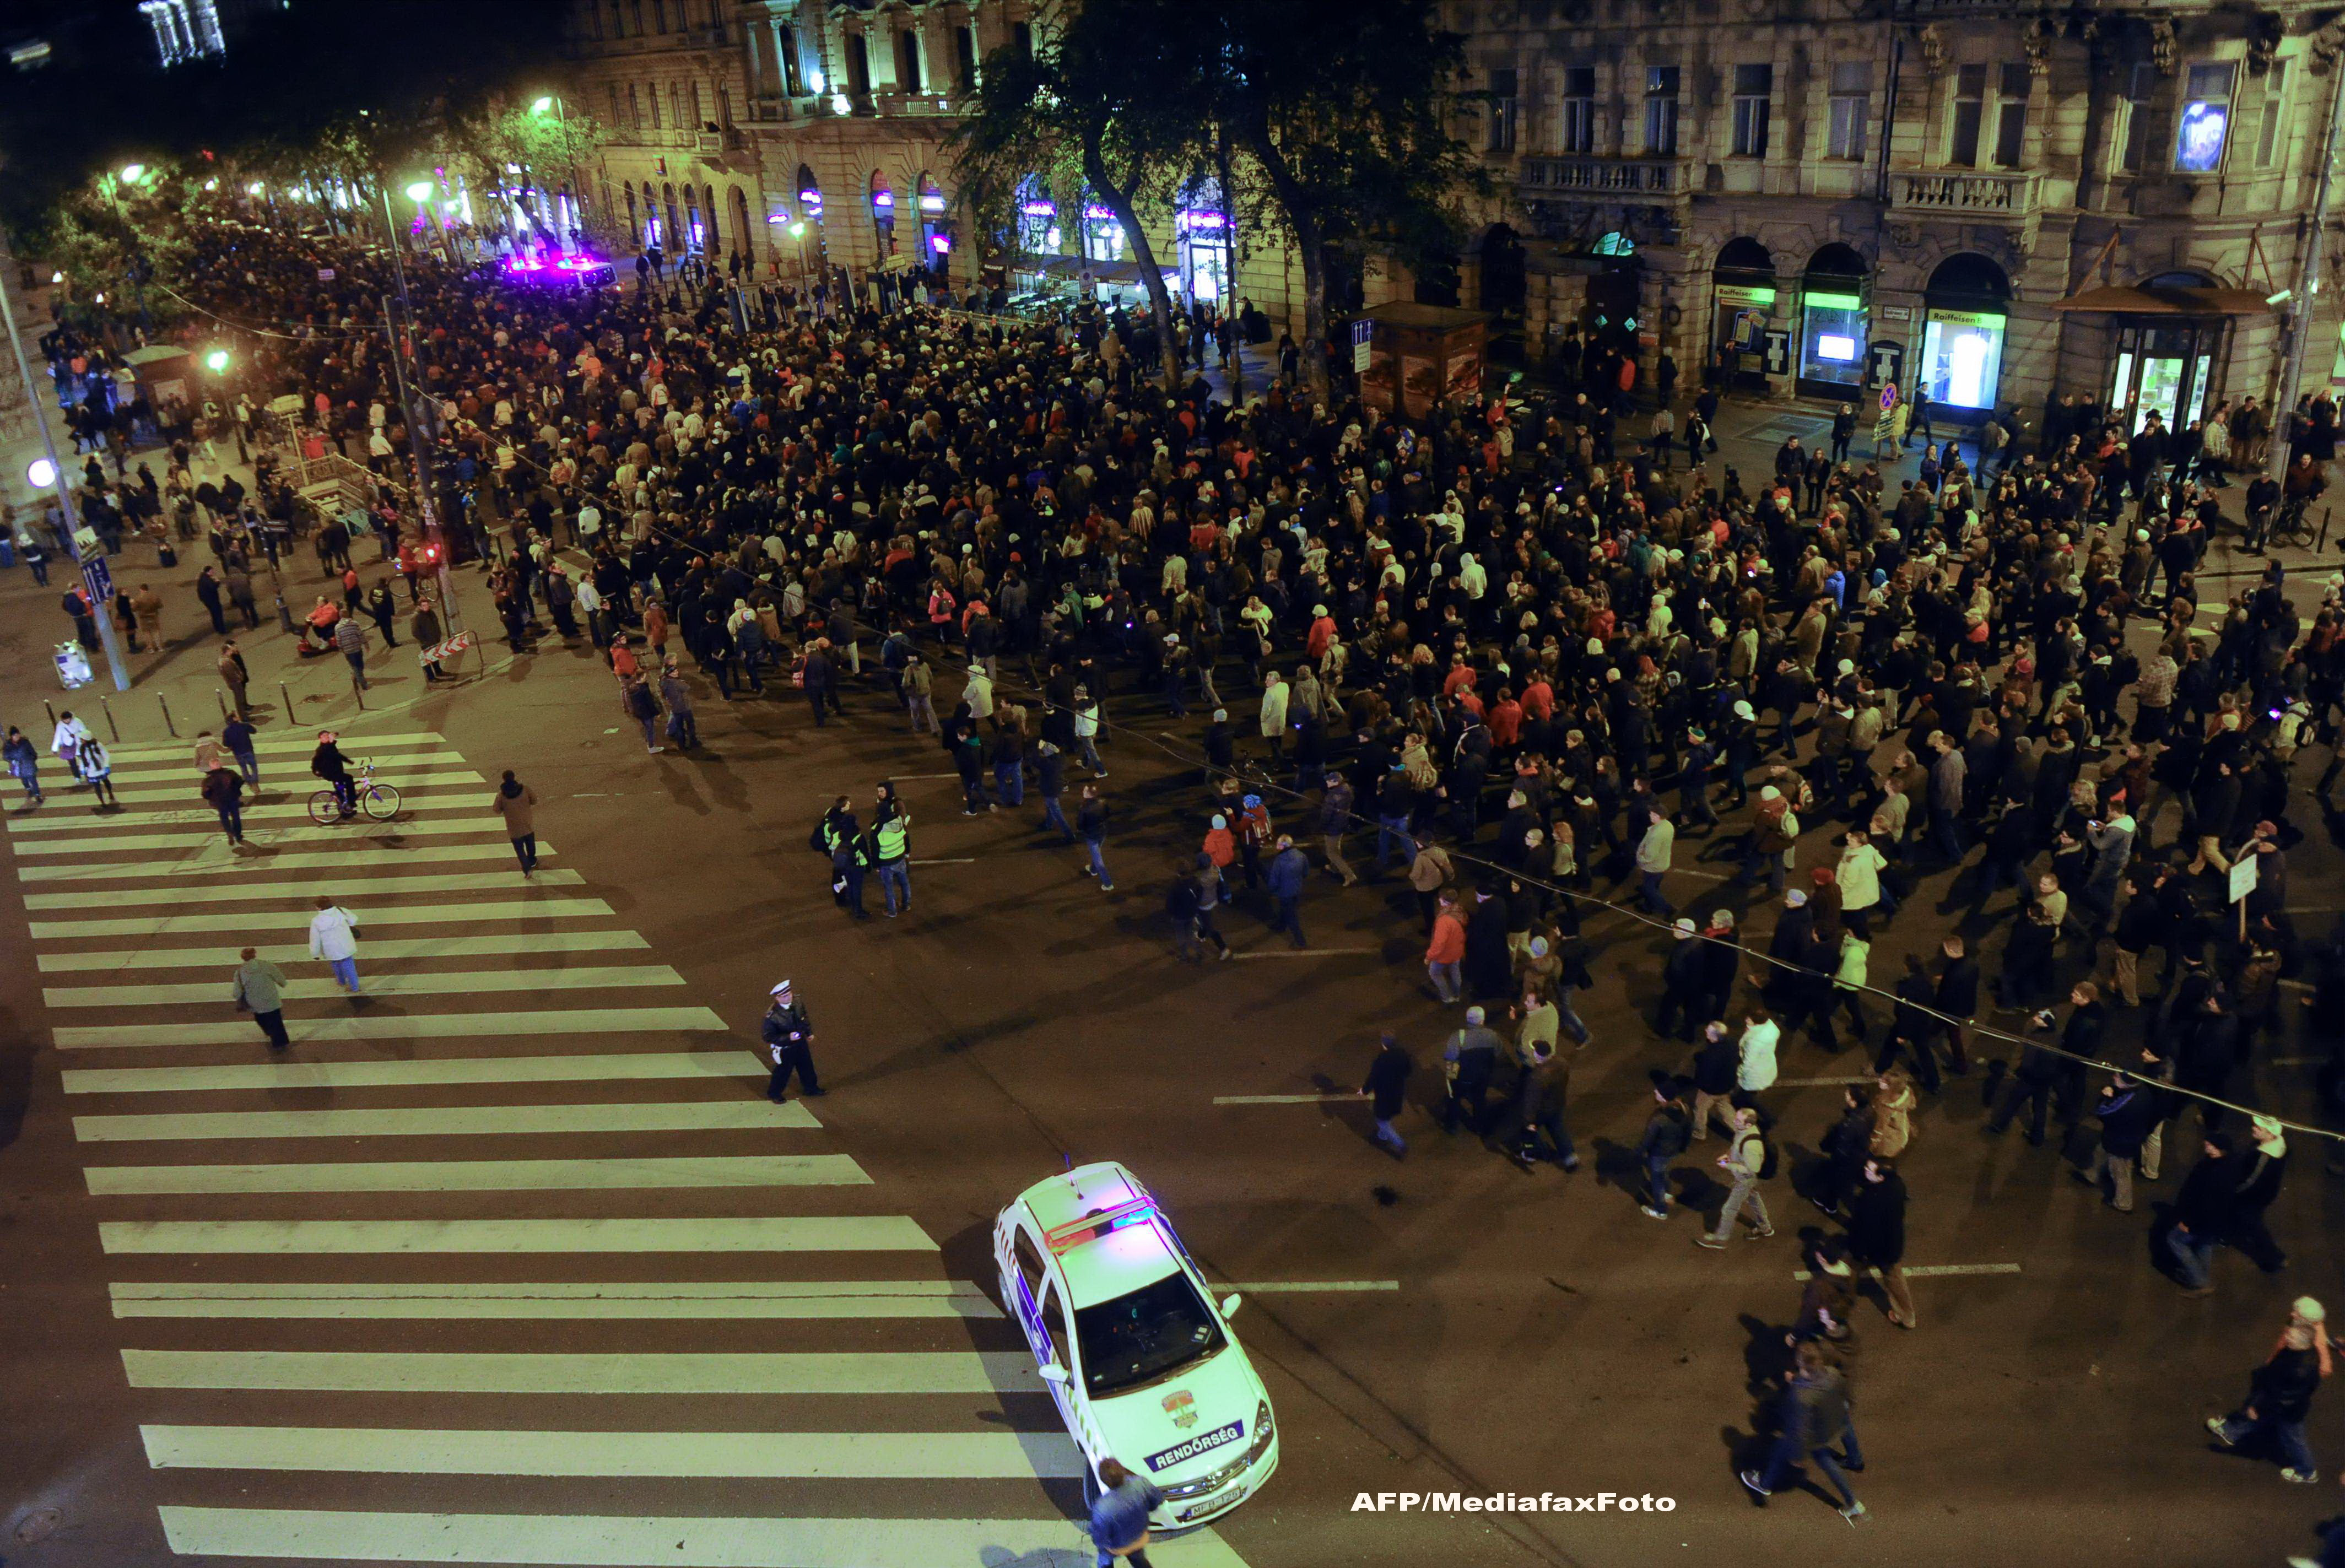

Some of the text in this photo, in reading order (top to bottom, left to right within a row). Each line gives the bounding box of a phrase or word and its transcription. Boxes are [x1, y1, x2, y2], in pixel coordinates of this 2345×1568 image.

[1719, 288, 1753, 297] Raiffeisen
[1933, 312, 1975, 323] Raiffeisen
[1155, 1427, 1239, 1469] RENDŐRSÉG
